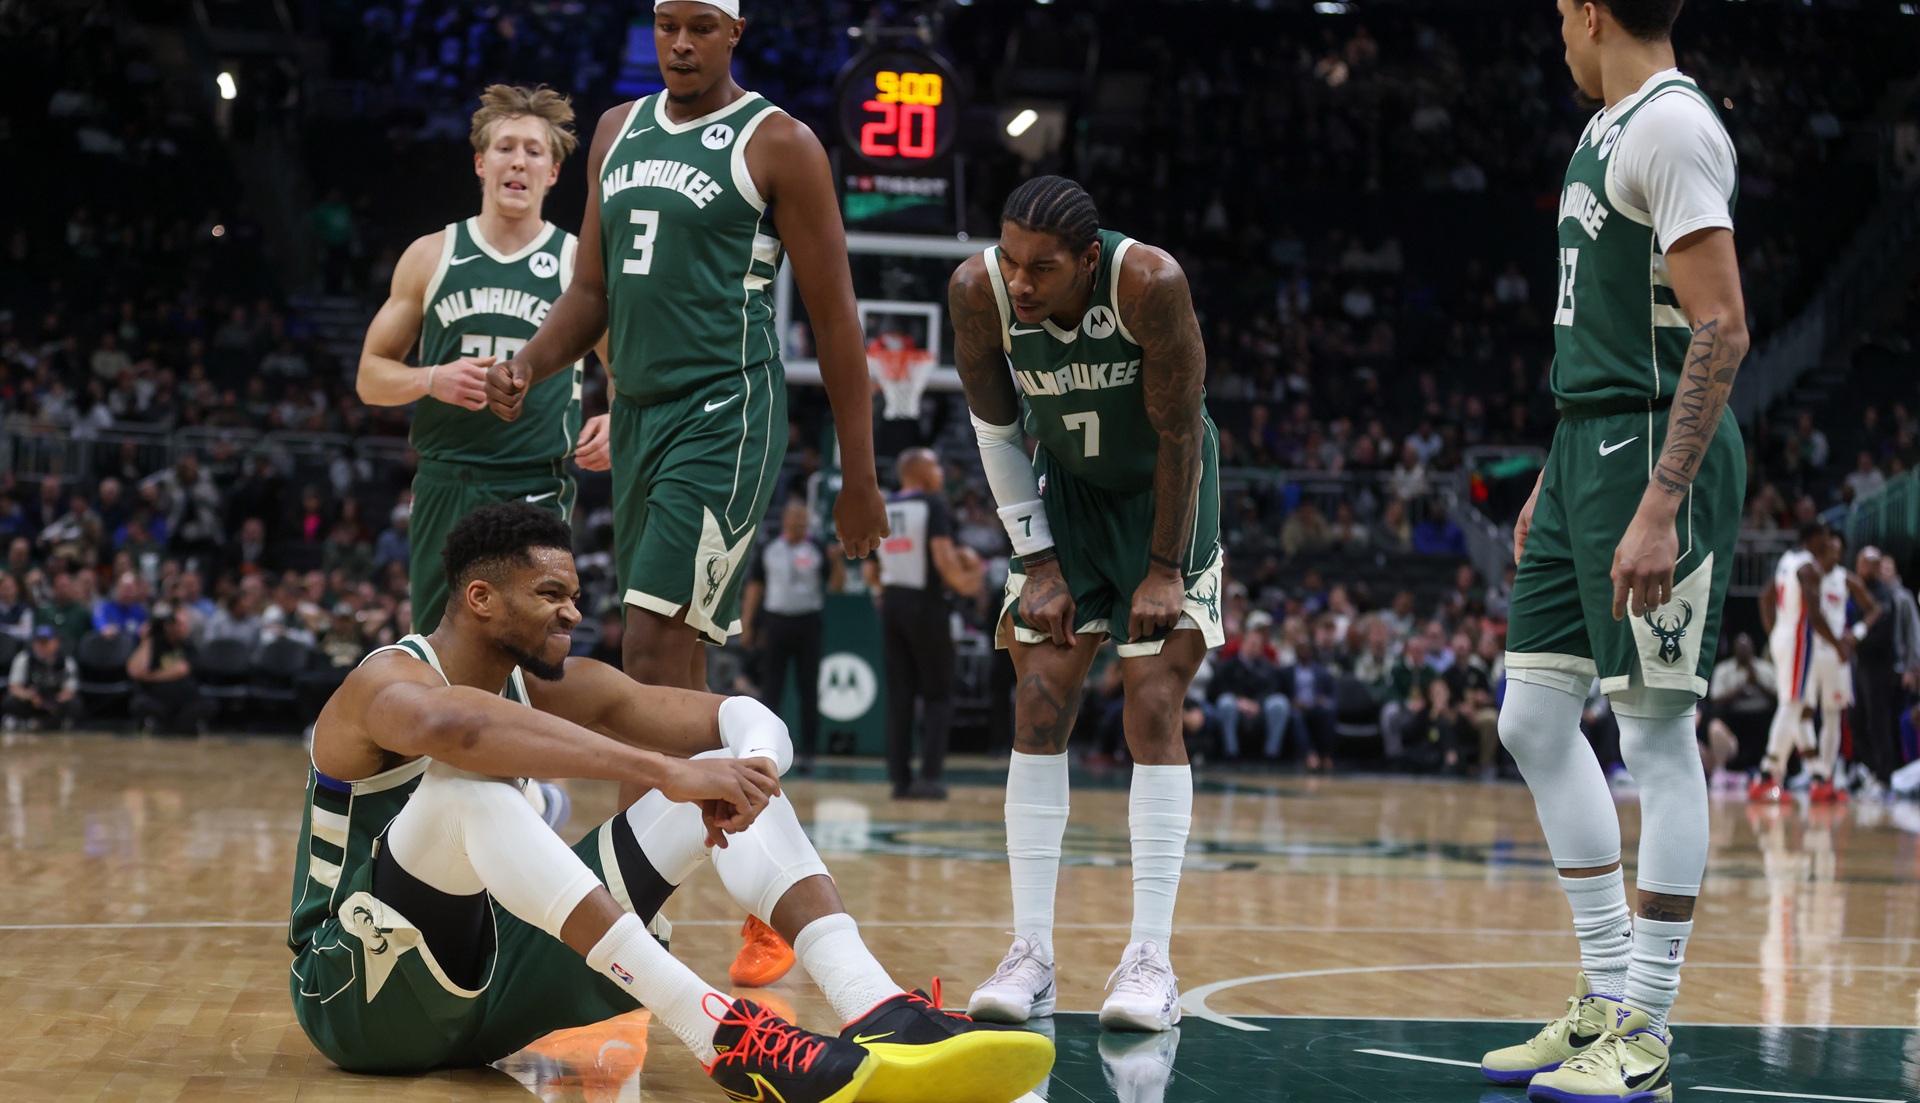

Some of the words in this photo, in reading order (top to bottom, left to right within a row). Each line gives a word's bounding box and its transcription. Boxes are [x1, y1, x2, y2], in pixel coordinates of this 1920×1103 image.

[861, 100, 936, 158] 20
[602, 160, 723, 209] MILWAUKEE
[622, 209, 659, 275] 3
[434, 287, 552, 328] MILWAUKE
[1016, 359, 1141, 396] ILWAUKEE
[1062, 411, 1100, 457] 7
[1017, 514, 1032, 538] 7
